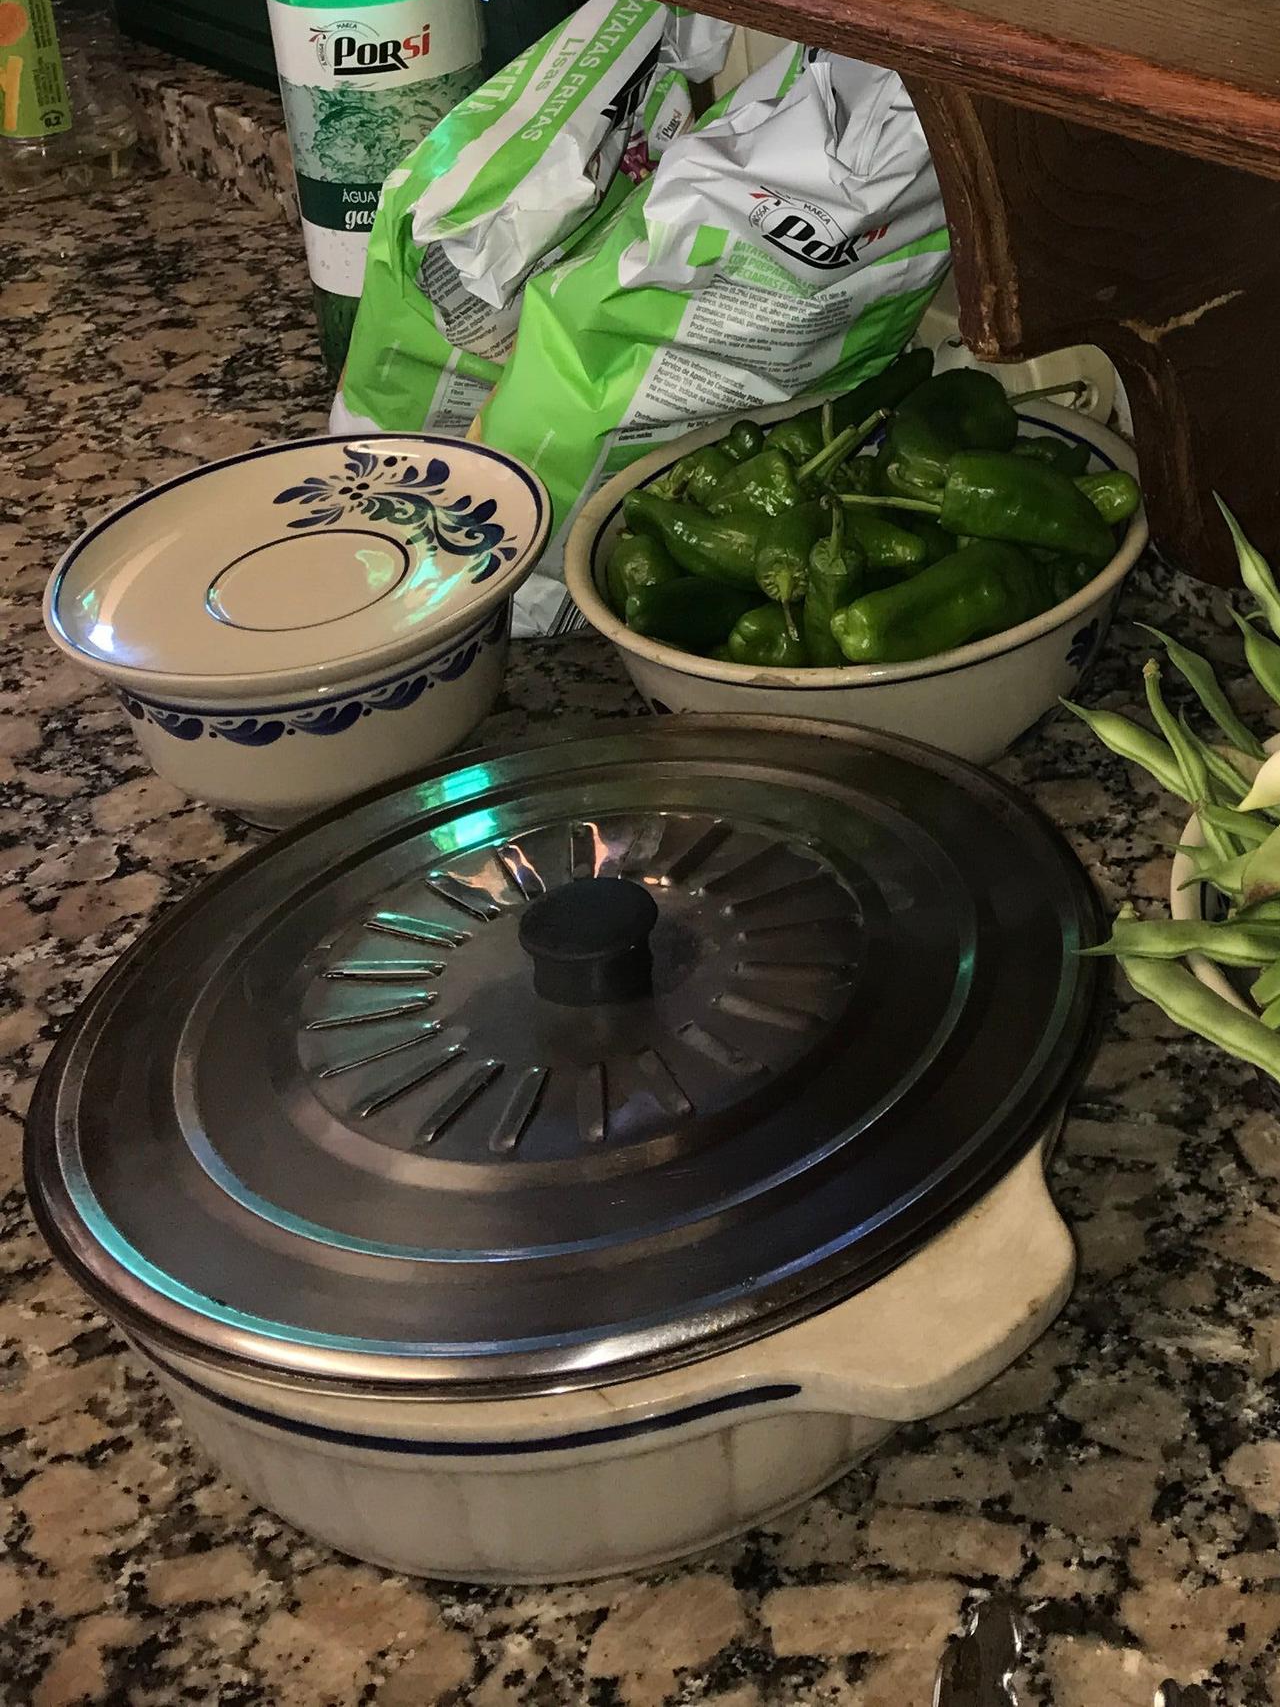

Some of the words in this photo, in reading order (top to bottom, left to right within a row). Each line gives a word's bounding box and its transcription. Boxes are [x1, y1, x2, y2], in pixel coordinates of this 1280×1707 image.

[535, 37, 585, 92] Lisas
[520, 72, 588, 142] FRITAS
[342, 188, 377, 204] ÁGUA
[803, 203, 832, 226] MARCA
